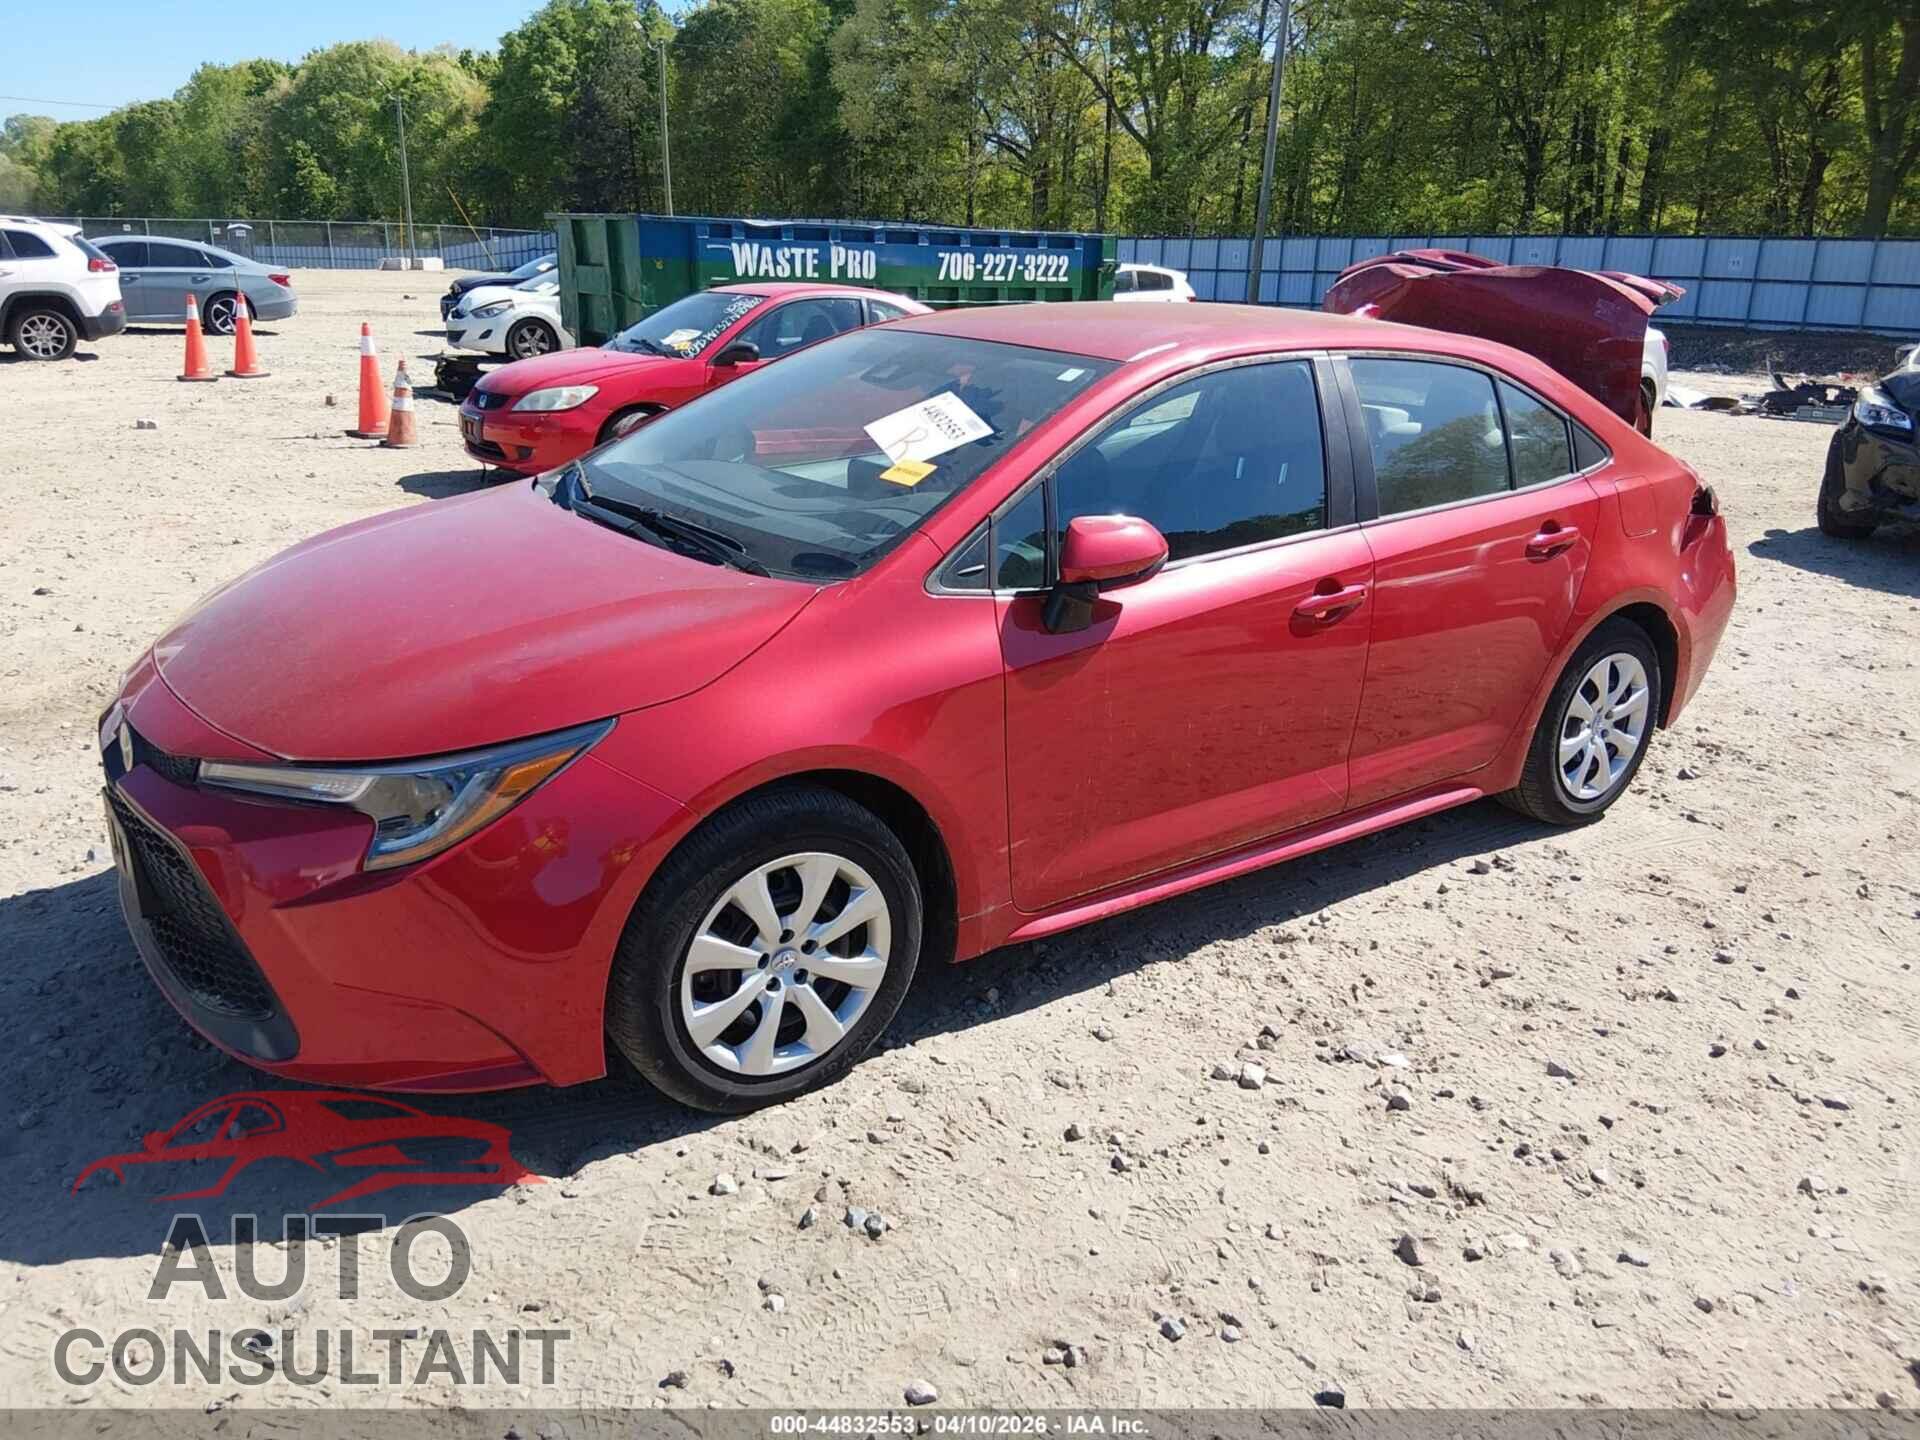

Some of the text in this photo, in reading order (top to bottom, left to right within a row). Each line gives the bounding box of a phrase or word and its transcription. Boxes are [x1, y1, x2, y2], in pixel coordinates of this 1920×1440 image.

[731, 242, 877, 280] WASTE PRO
[937, 252, 1069, 282] 706-227-3222
